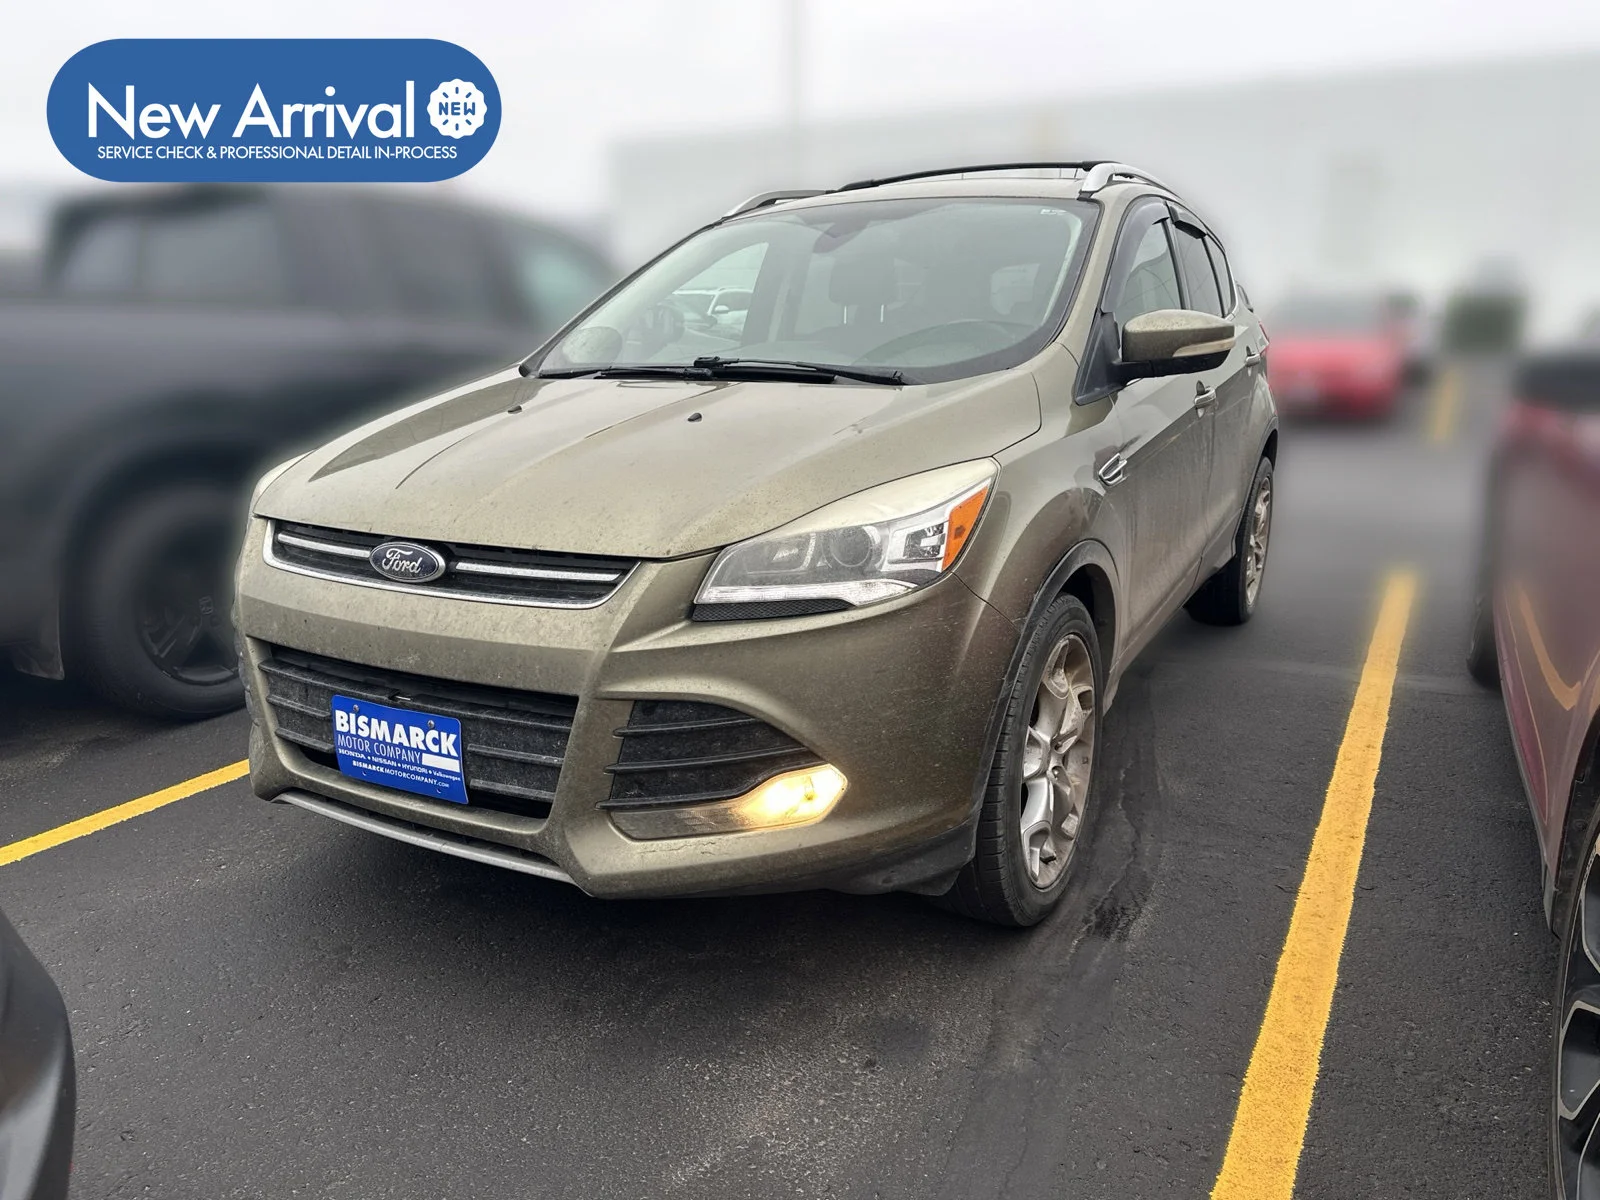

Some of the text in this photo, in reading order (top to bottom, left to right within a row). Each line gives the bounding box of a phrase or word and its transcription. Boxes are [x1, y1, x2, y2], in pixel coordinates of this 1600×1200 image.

[381, 547, 423, 573] Ford
[335, 710, 458, 757] BISMARCK
[337, 734, 421, 764] MOTOR COMPANY
